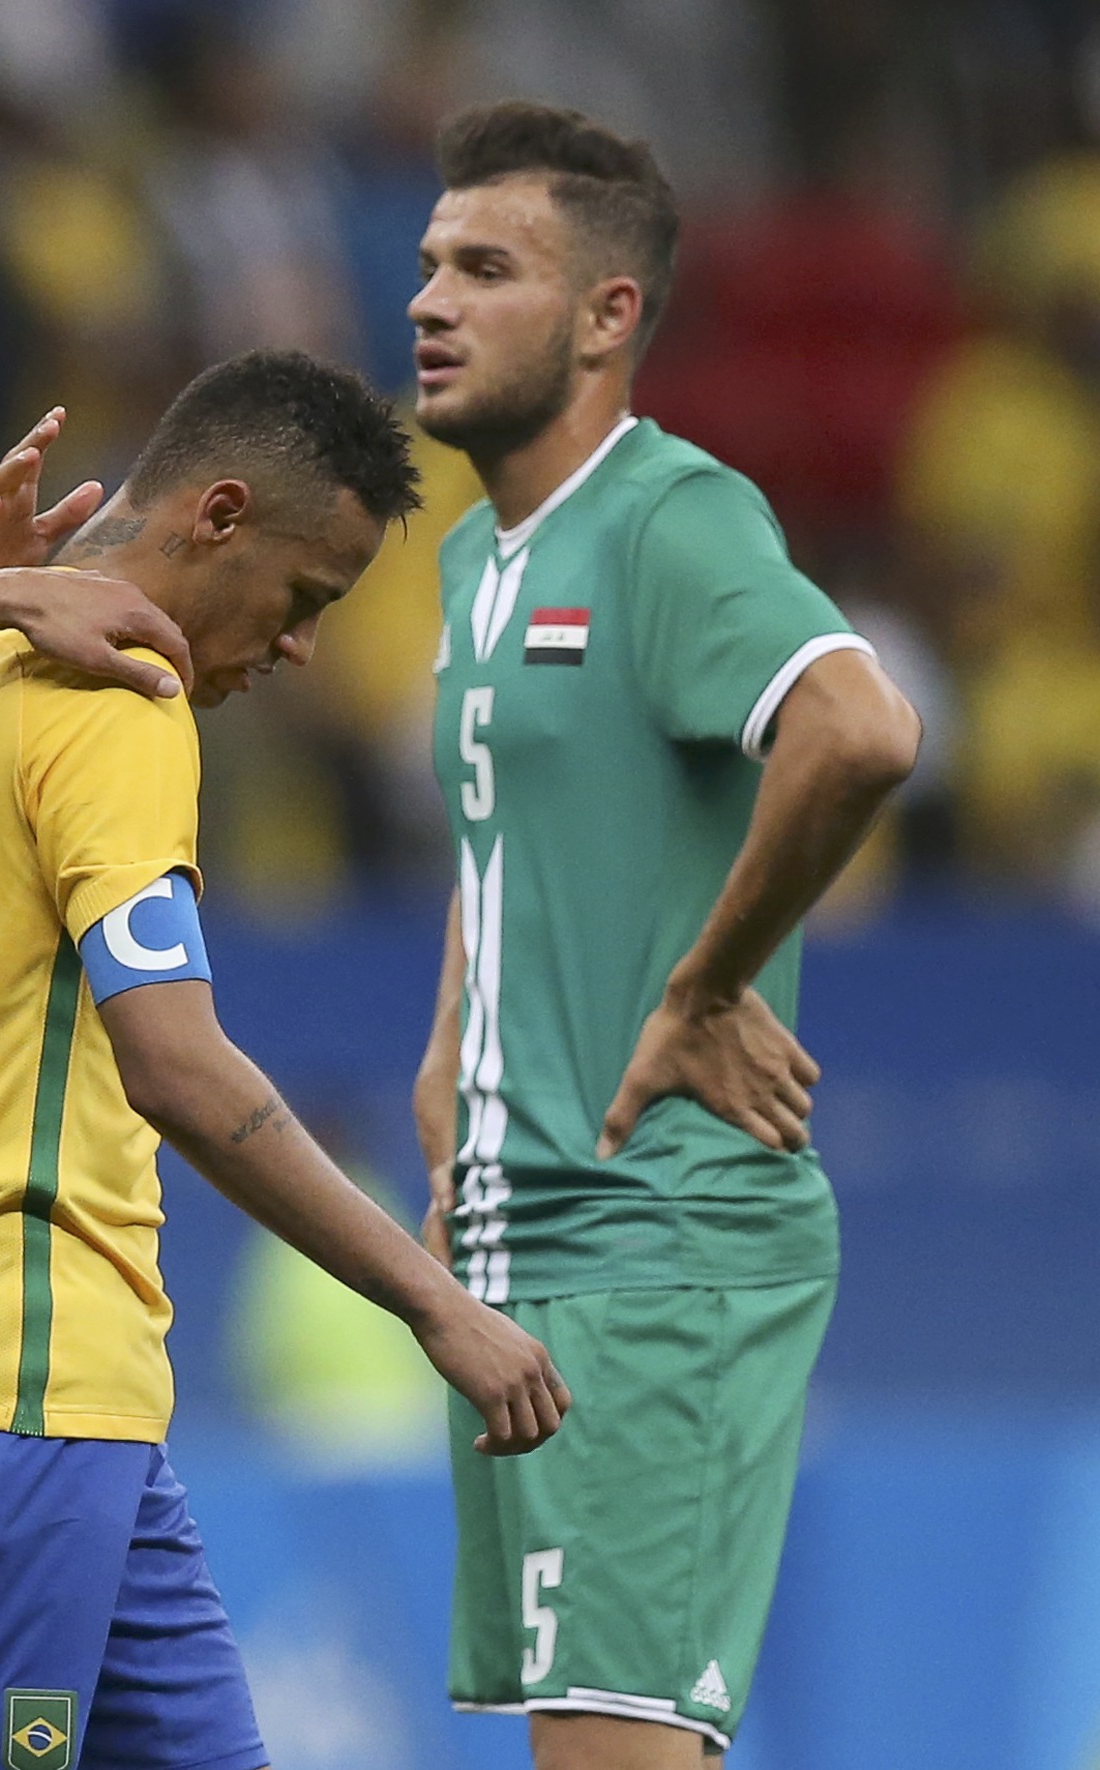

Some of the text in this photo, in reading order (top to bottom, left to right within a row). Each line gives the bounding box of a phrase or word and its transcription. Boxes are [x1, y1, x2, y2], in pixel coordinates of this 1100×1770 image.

[459, 685, 496, 822] 5
[102, 877, 189, 971] C
[520, 1547, 564, 1685] 5
